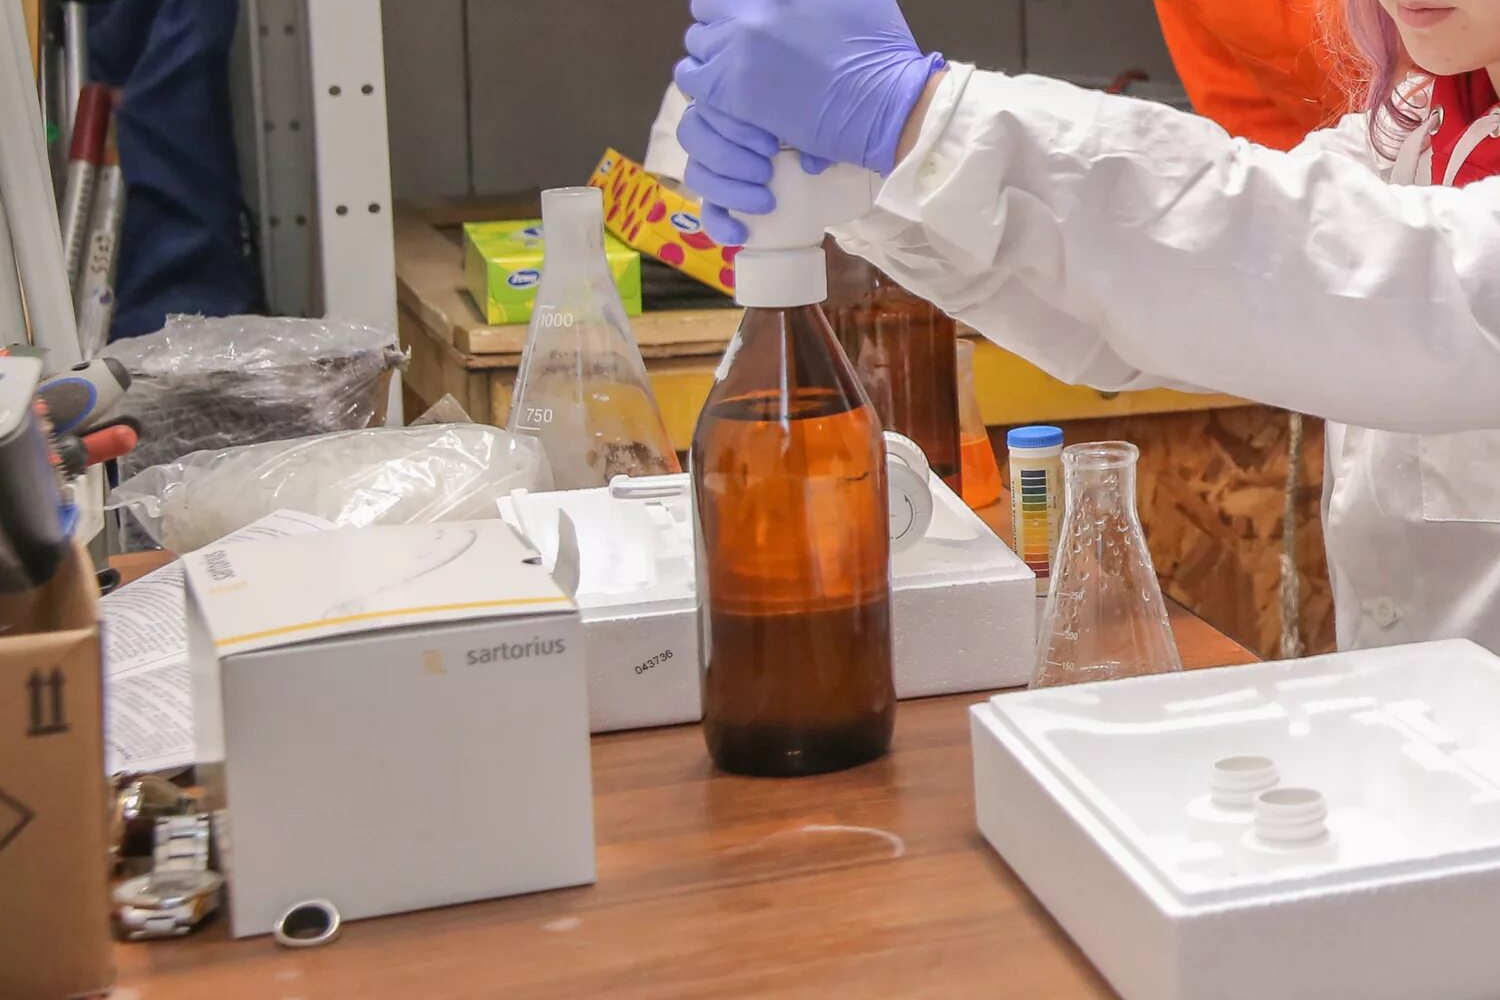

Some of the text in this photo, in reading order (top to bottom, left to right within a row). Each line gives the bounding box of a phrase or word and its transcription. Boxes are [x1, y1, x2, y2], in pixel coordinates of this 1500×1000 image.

[541, 313, 573, 328] 1000
[527, 408, 553, 423] 750
[466, 635, 566, 666] sartorius
[635, 649, 673, 675] 043736
